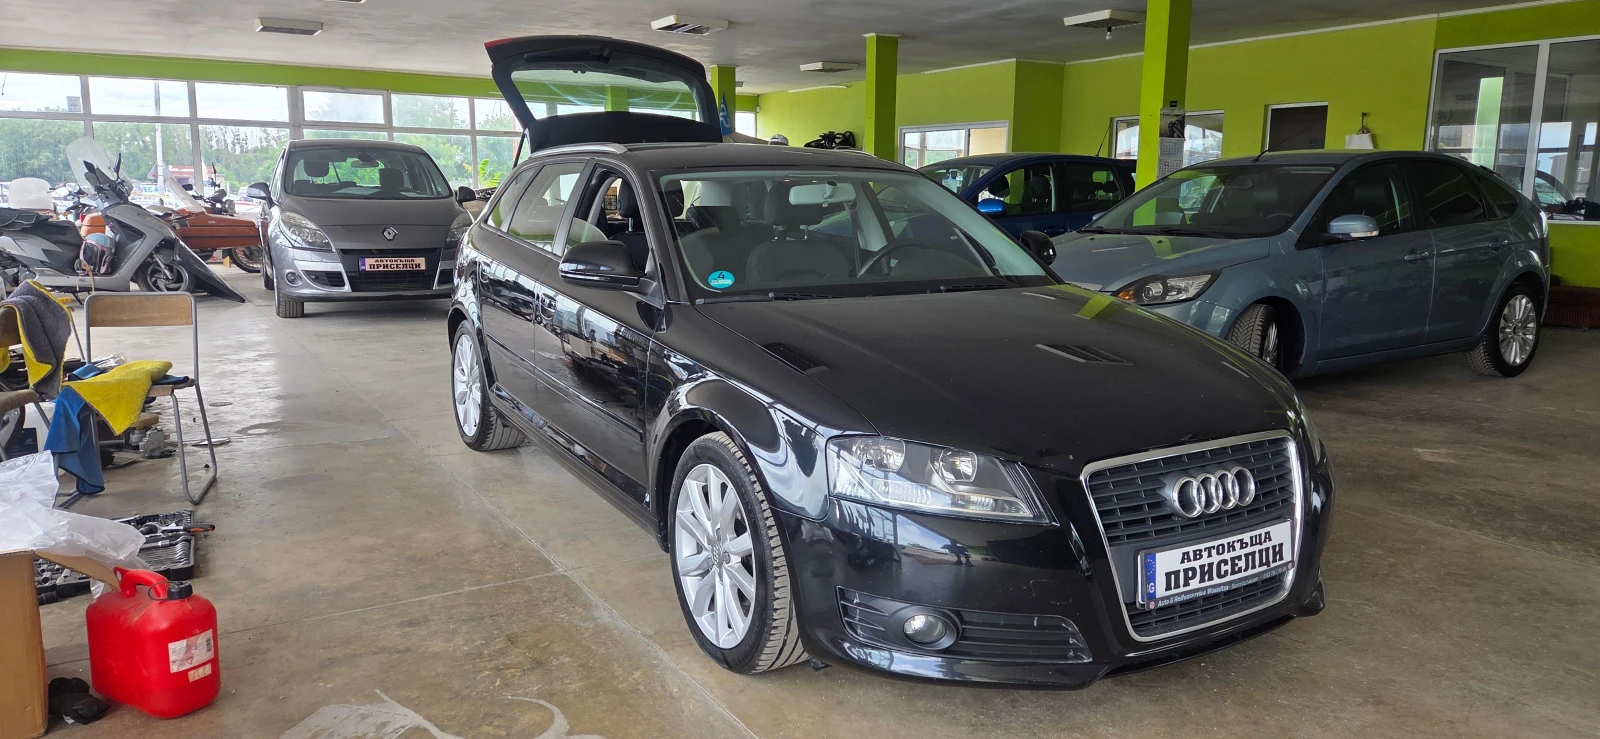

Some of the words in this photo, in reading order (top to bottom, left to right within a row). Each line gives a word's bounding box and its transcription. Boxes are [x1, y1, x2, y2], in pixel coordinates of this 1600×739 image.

[718, 271, 725, 280] 4
[1180, 531, 1272, 564] АВТОКЪЩА
[1165, 542, 1284, 592] ПРИСЕЛЦИ
[1174, 590, 1207, 603] Reifenservice
